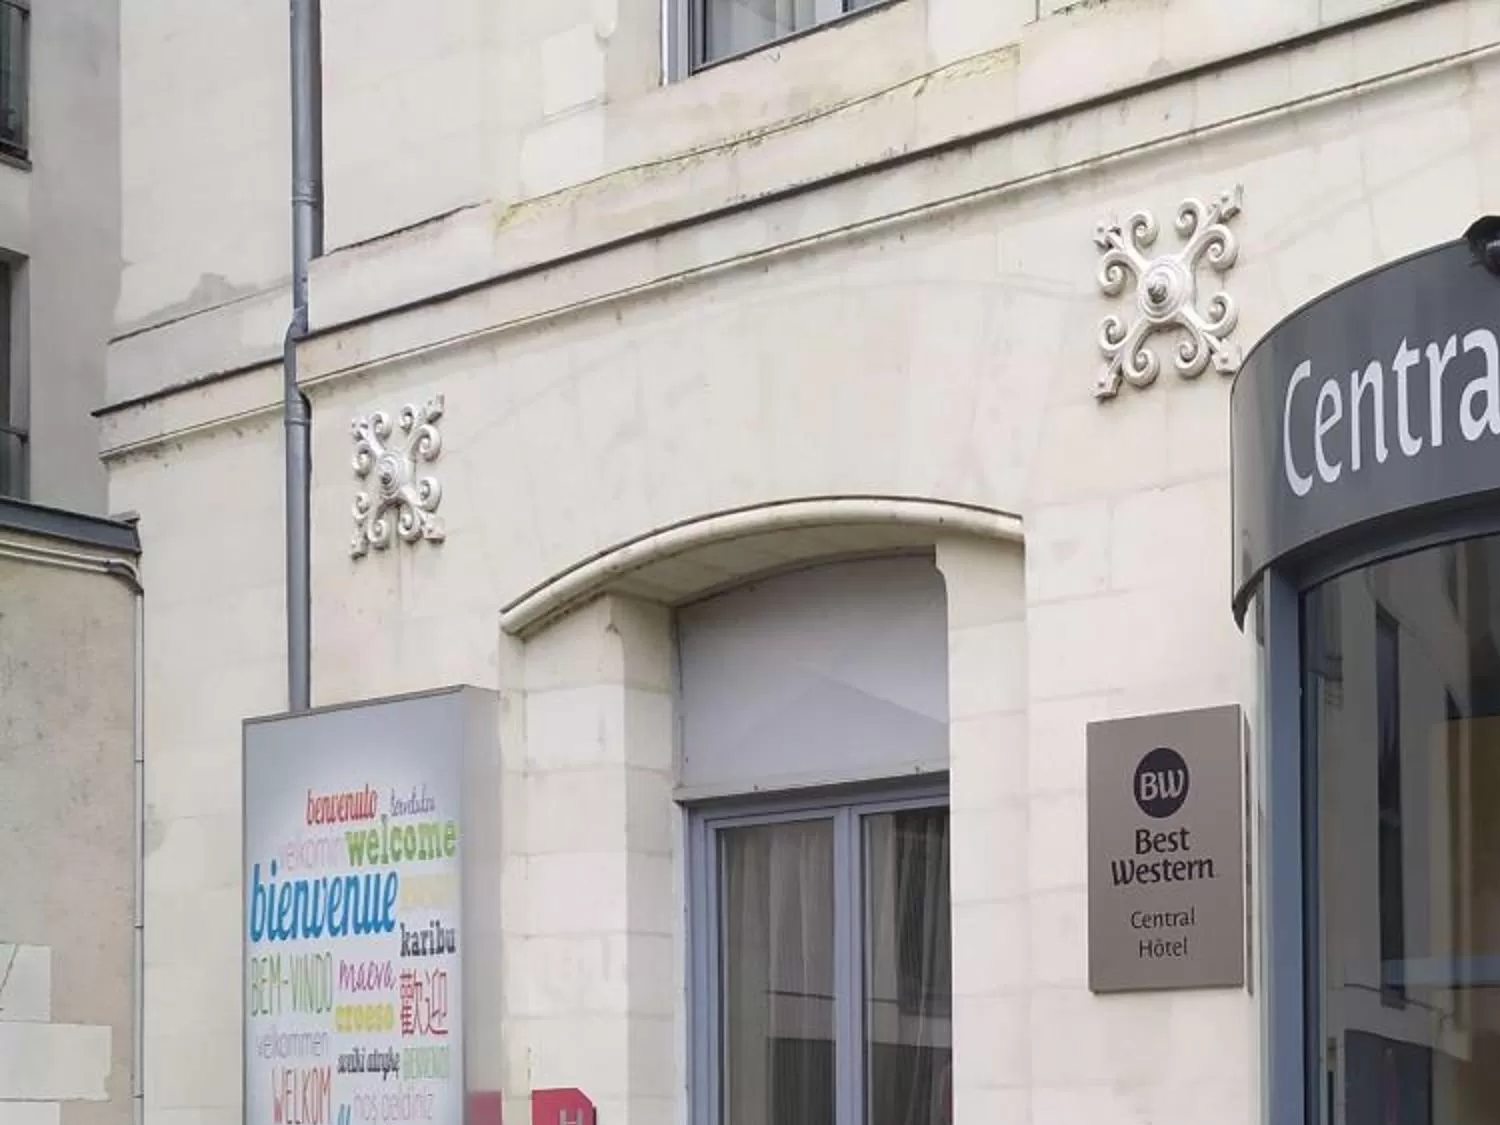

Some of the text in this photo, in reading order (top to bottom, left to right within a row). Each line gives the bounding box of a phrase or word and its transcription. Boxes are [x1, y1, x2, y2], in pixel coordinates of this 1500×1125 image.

[1140, 769, 1184, 800] BW
[306, 784, 378, 825] benvenuto
[345, 815, 457, 866] welcome
[1135, 827, 1190, 855] Best
[1111, 857, 1214, 886] Western
[250, 859, 398, 943] bienvenue
[1130, 905, 1195, 929] Central
[399, 919, 457, 957] karibu
[1138, 936, 1188, 959] Hôtel
[251, 952, 333, 1017] BEM-VINDO
[272, 1065, 332, 1125] WELKOM
